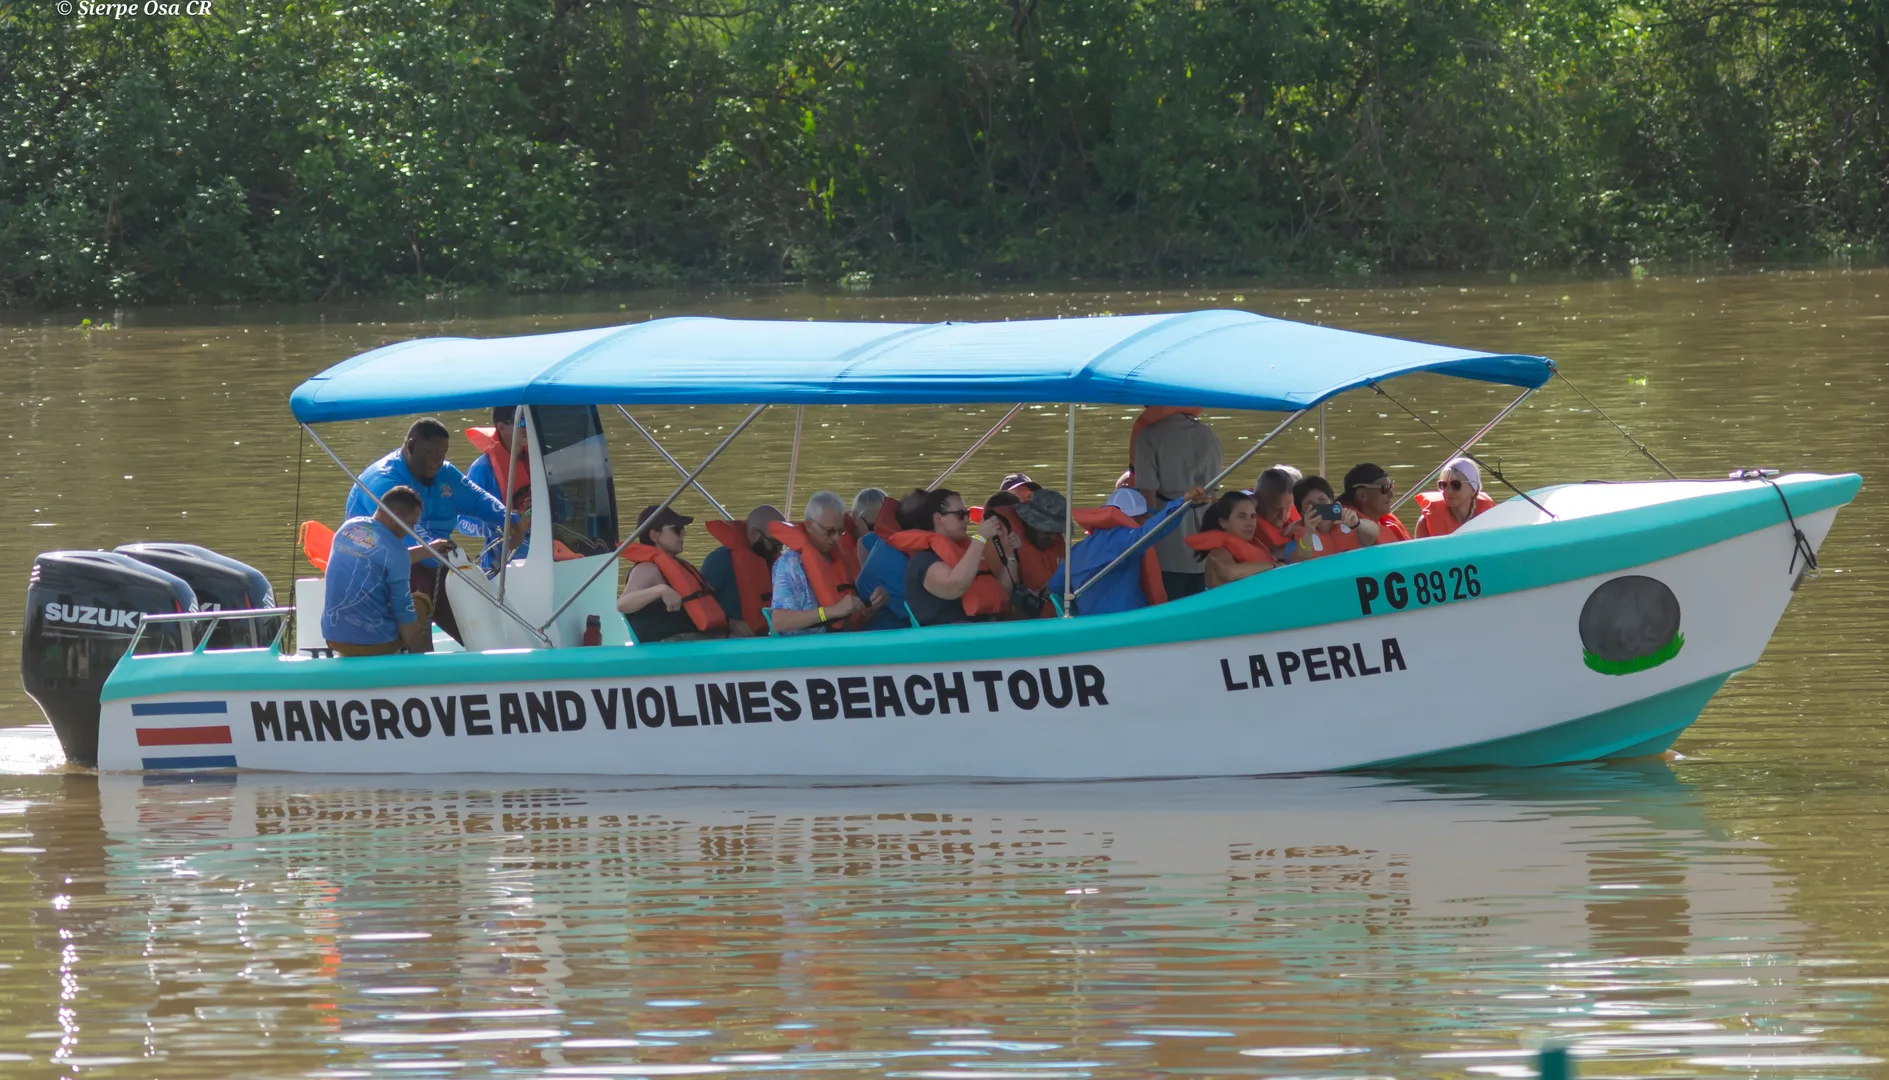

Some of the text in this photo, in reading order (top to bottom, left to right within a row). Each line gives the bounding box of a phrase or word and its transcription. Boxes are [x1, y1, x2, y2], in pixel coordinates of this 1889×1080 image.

[45, 603, 147, 629] SUZUK
[1356, 571, 1409, 616] PG
[1220, 637, 1407, 691] LA PERLA
[251, 664, 1109, 742] MANGROVE AND VIOLINES BEACH TOUR
